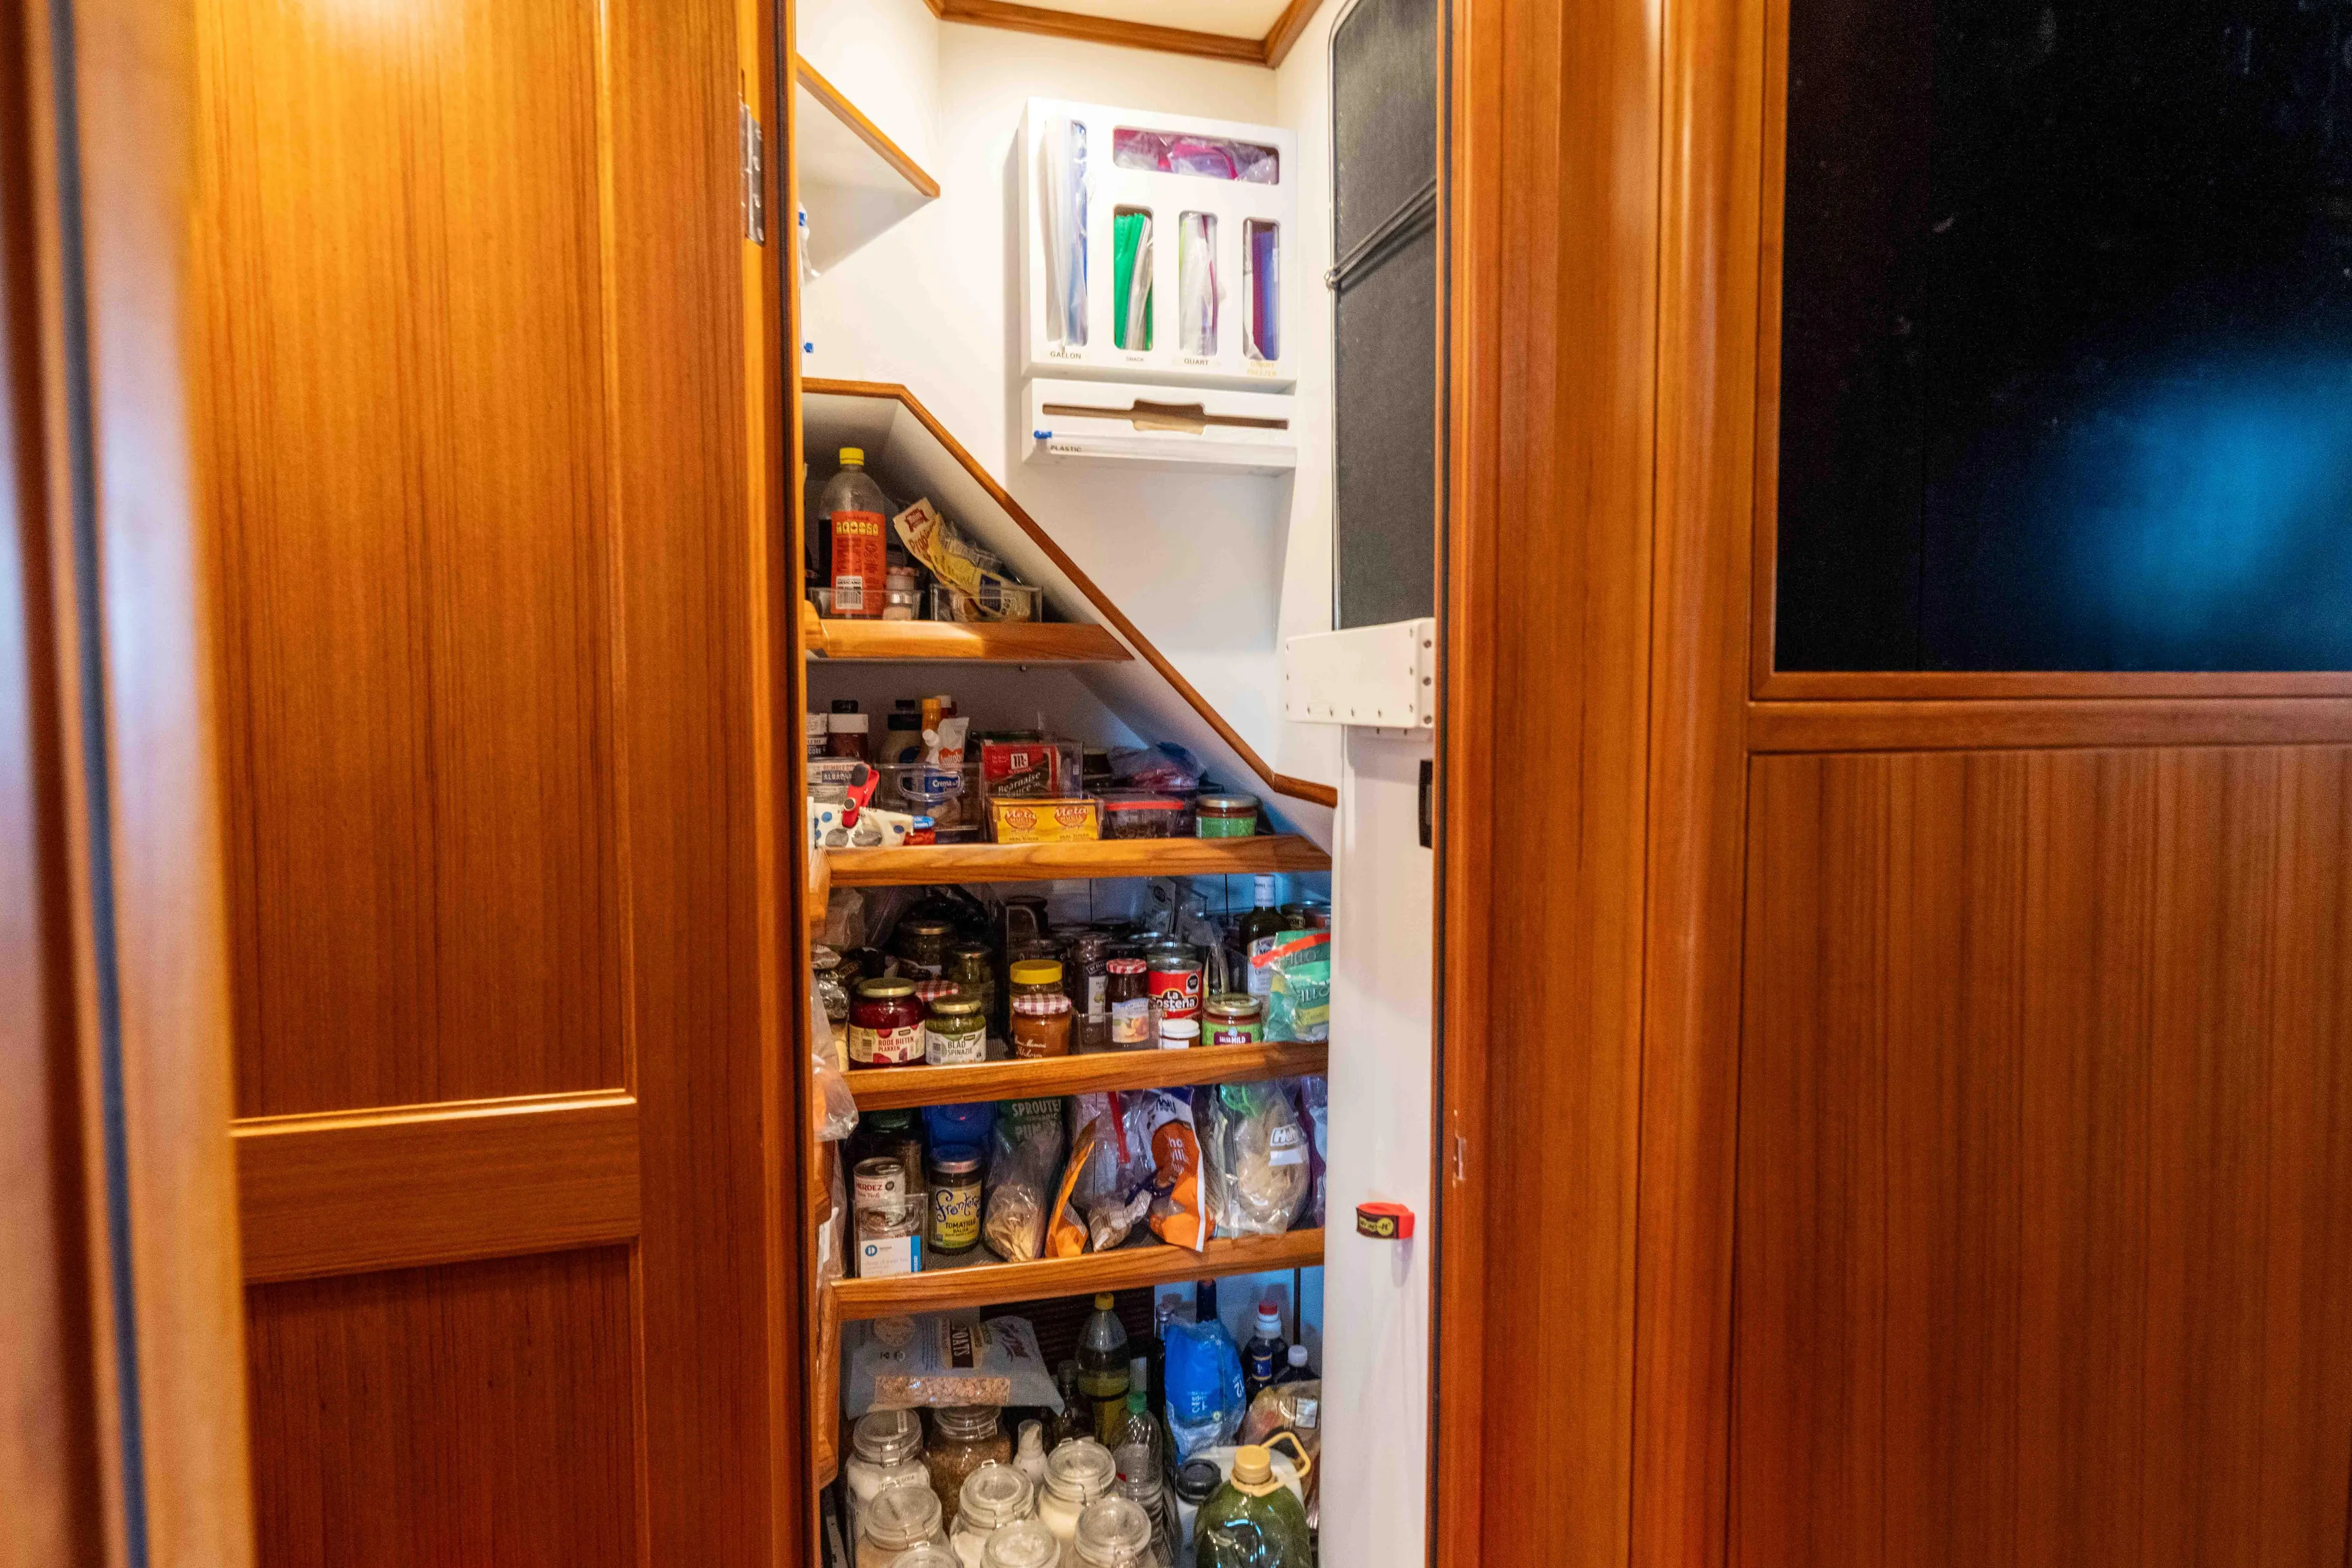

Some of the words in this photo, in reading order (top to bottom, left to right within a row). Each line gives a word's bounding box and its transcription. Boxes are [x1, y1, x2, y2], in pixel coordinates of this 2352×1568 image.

[1050, 351, 1081, 360] GALLON
[998, 772, 1041, 793] Bearnaise
[1167, 991, 1178, 1000] La
[895, 1036, 914, 1045] BIETEN
[945, 1218, 976, 1229] TOMATILLO
